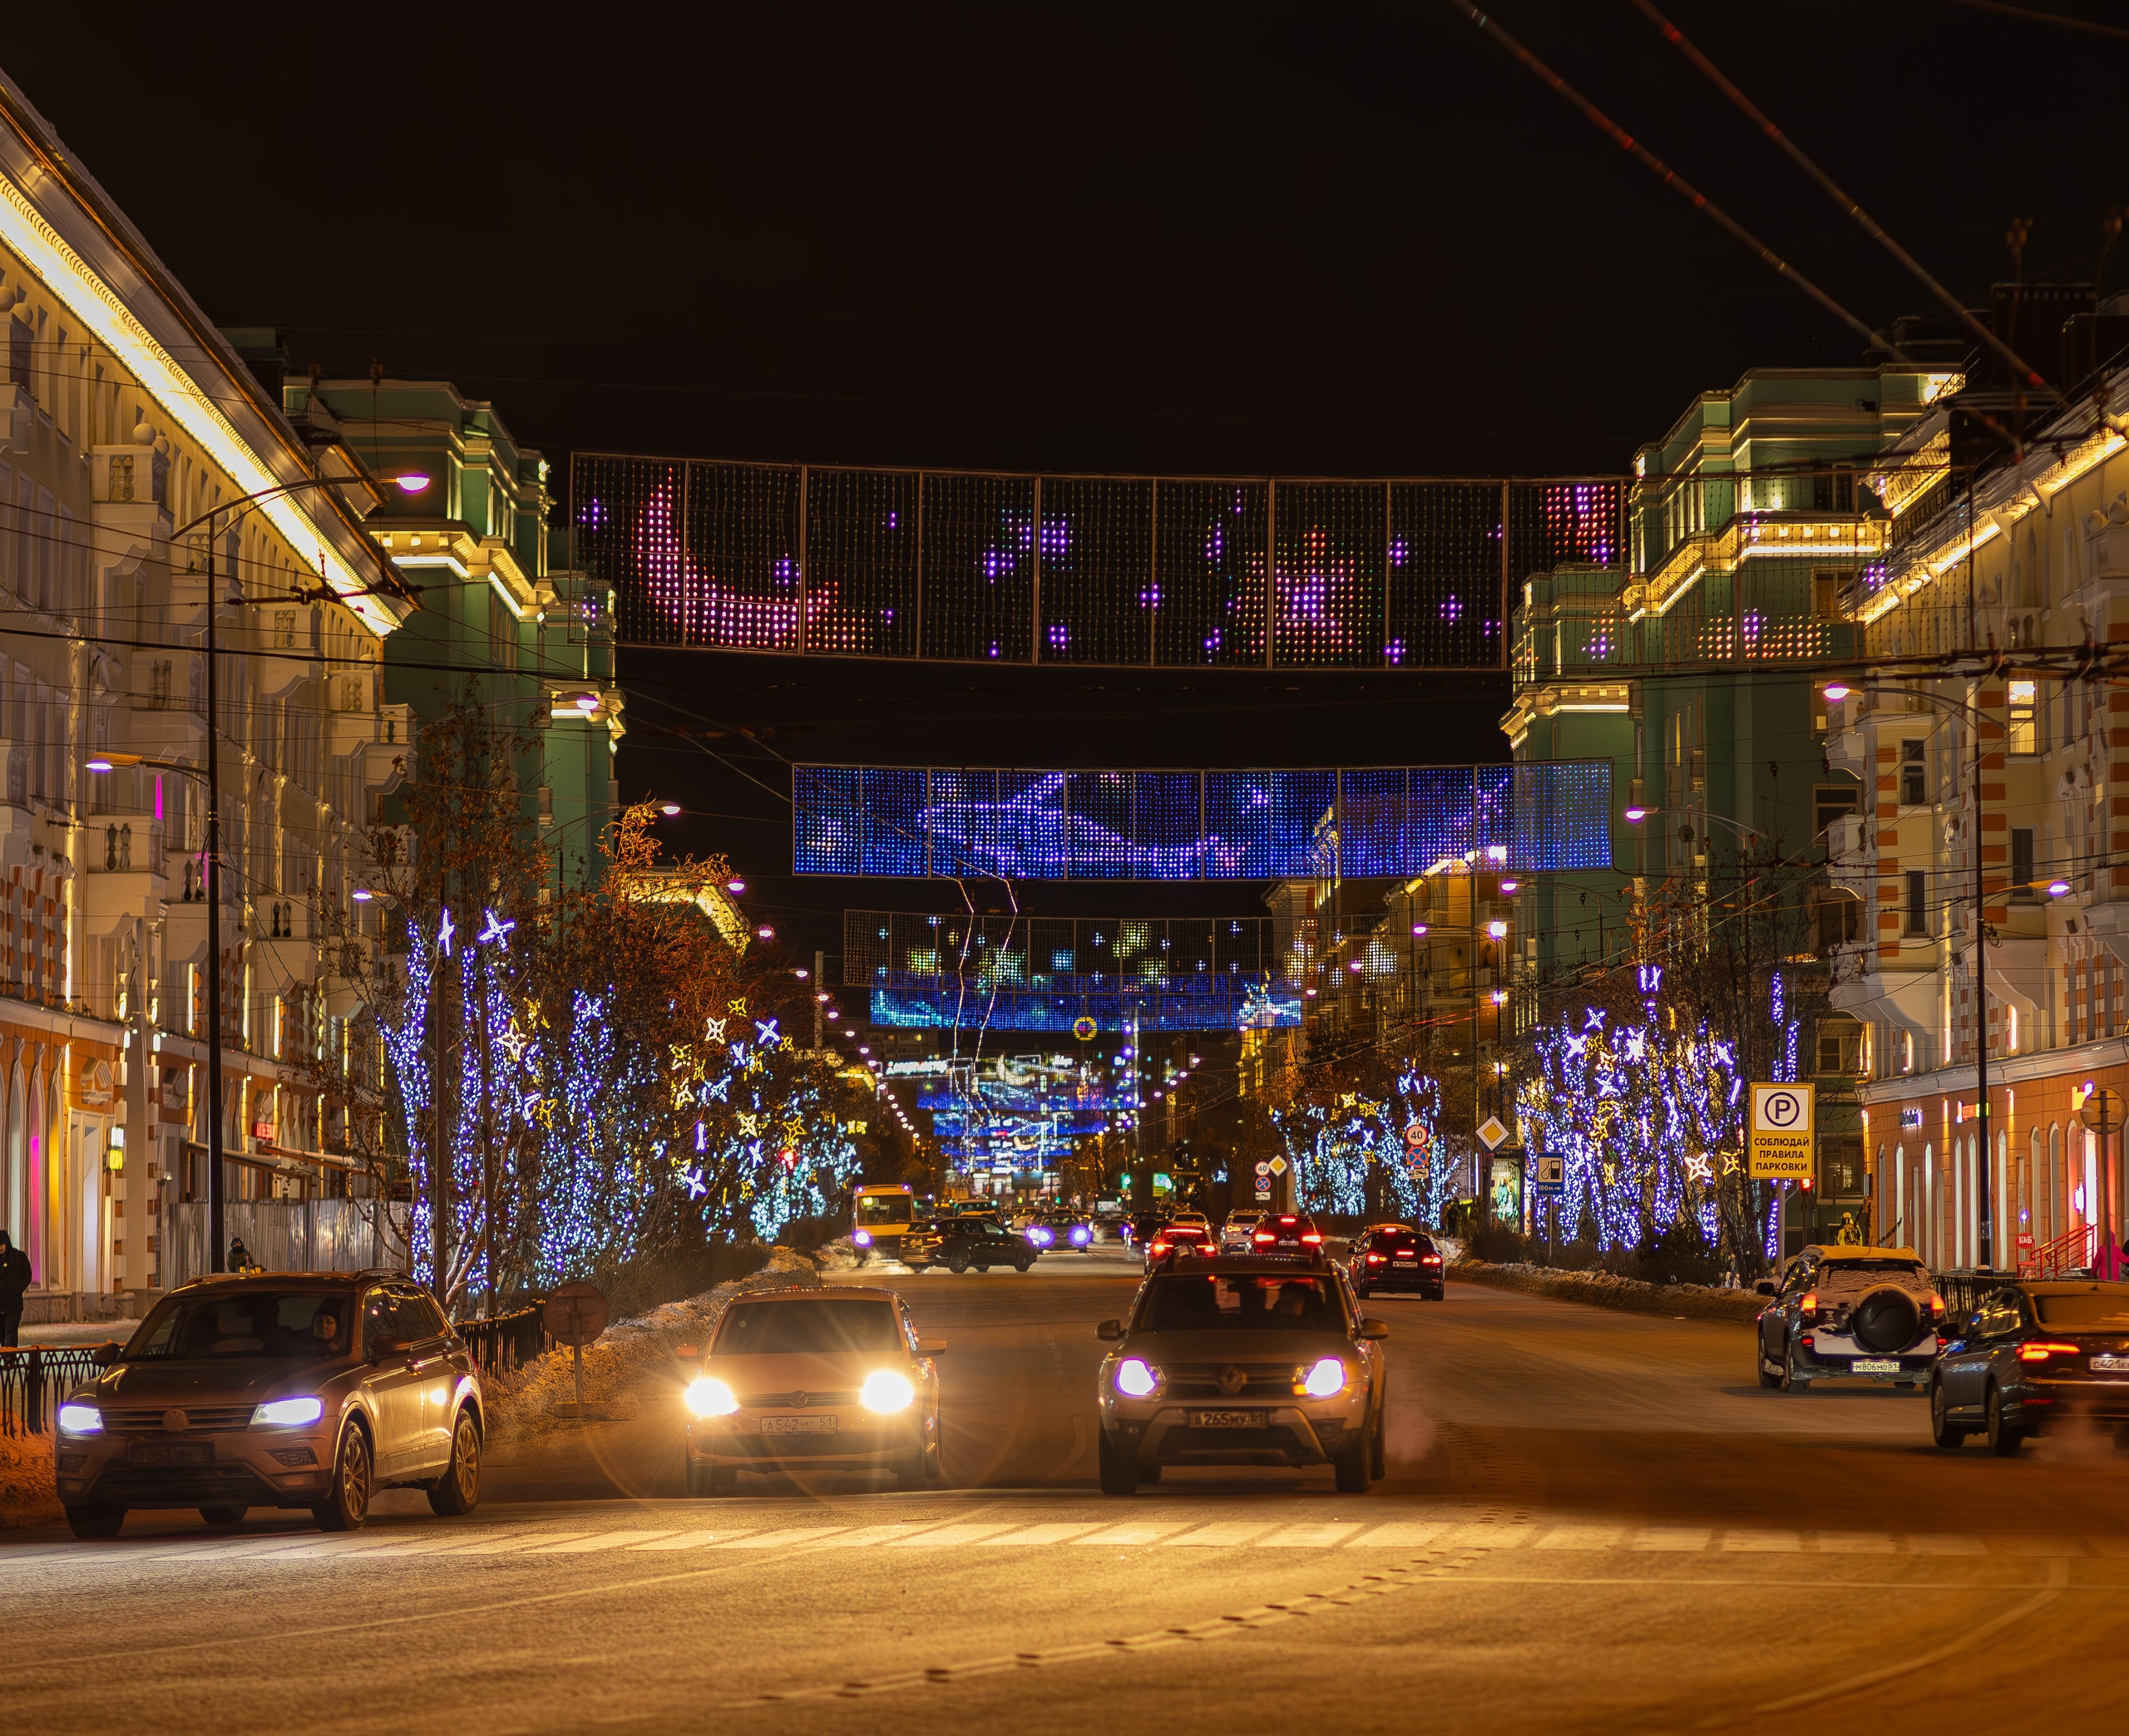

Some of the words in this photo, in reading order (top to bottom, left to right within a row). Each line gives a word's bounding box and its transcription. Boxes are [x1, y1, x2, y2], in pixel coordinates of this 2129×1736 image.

[1775, 1099, 1791, 1120] P
[1410, 1131, 1423, 1140] 40
[1754, 1137, 1810, 1148] СОБЛЮДАЙ
[1759, 1150, 1805, 1159] ПРАВИЛА
[1756, 1162, 1808, 1171] ПАРКОВКИ
